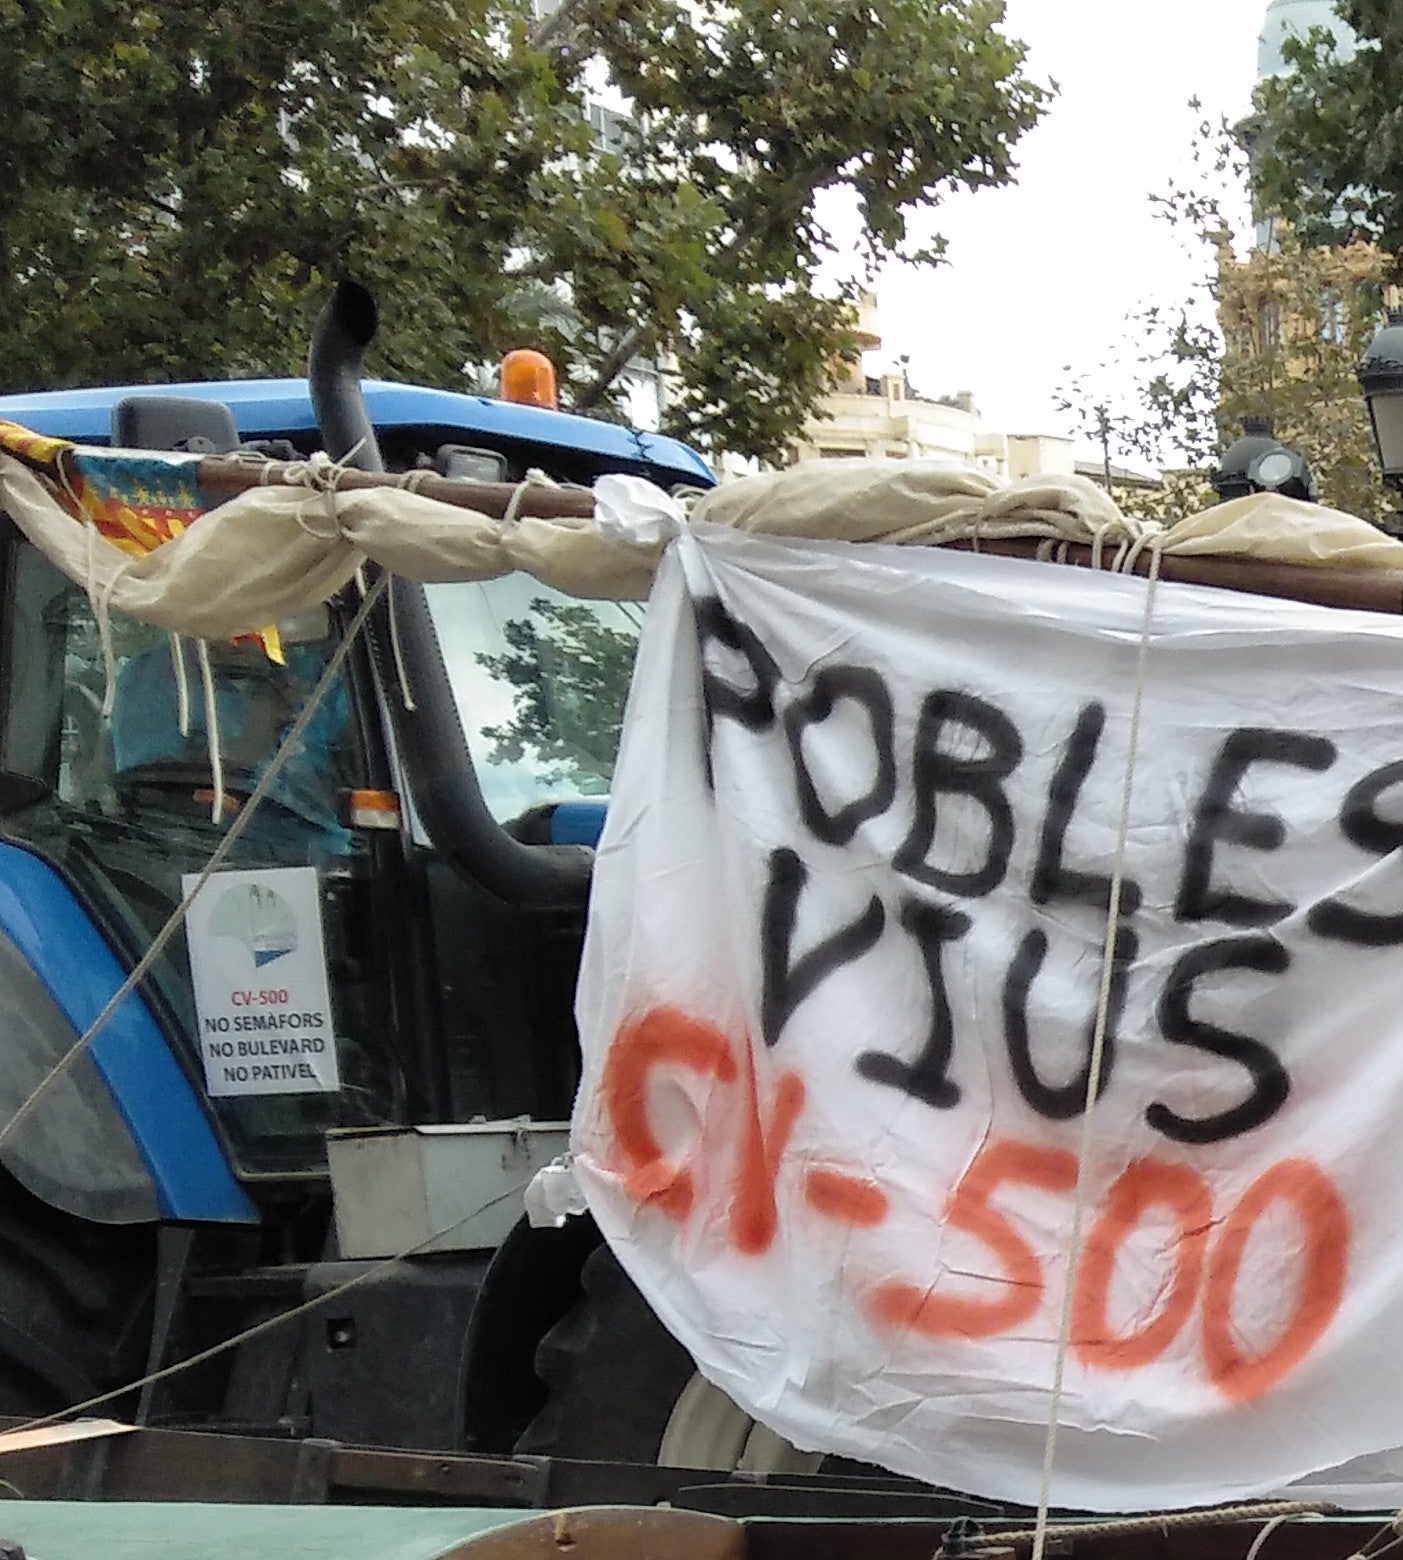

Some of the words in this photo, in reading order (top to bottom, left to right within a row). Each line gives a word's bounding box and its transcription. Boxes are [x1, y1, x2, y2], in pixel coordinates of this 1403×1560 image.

[230, 988, 290, 1007] CV-500
[760, 847, 1292, 1146] VIUS
[204, 1016, 230, 1033] NO
[233, 1010, 324, 1032] SEMÀFORS
[208, 1041, 234, 1058] NO
[237, 1037, 326, 1056] BULEVARD
[223, 1066, 249, 1083] NO
[252, 1063, 317, 1082] PATIVEL
[602, 1003, 1350, 1402] CV-500
